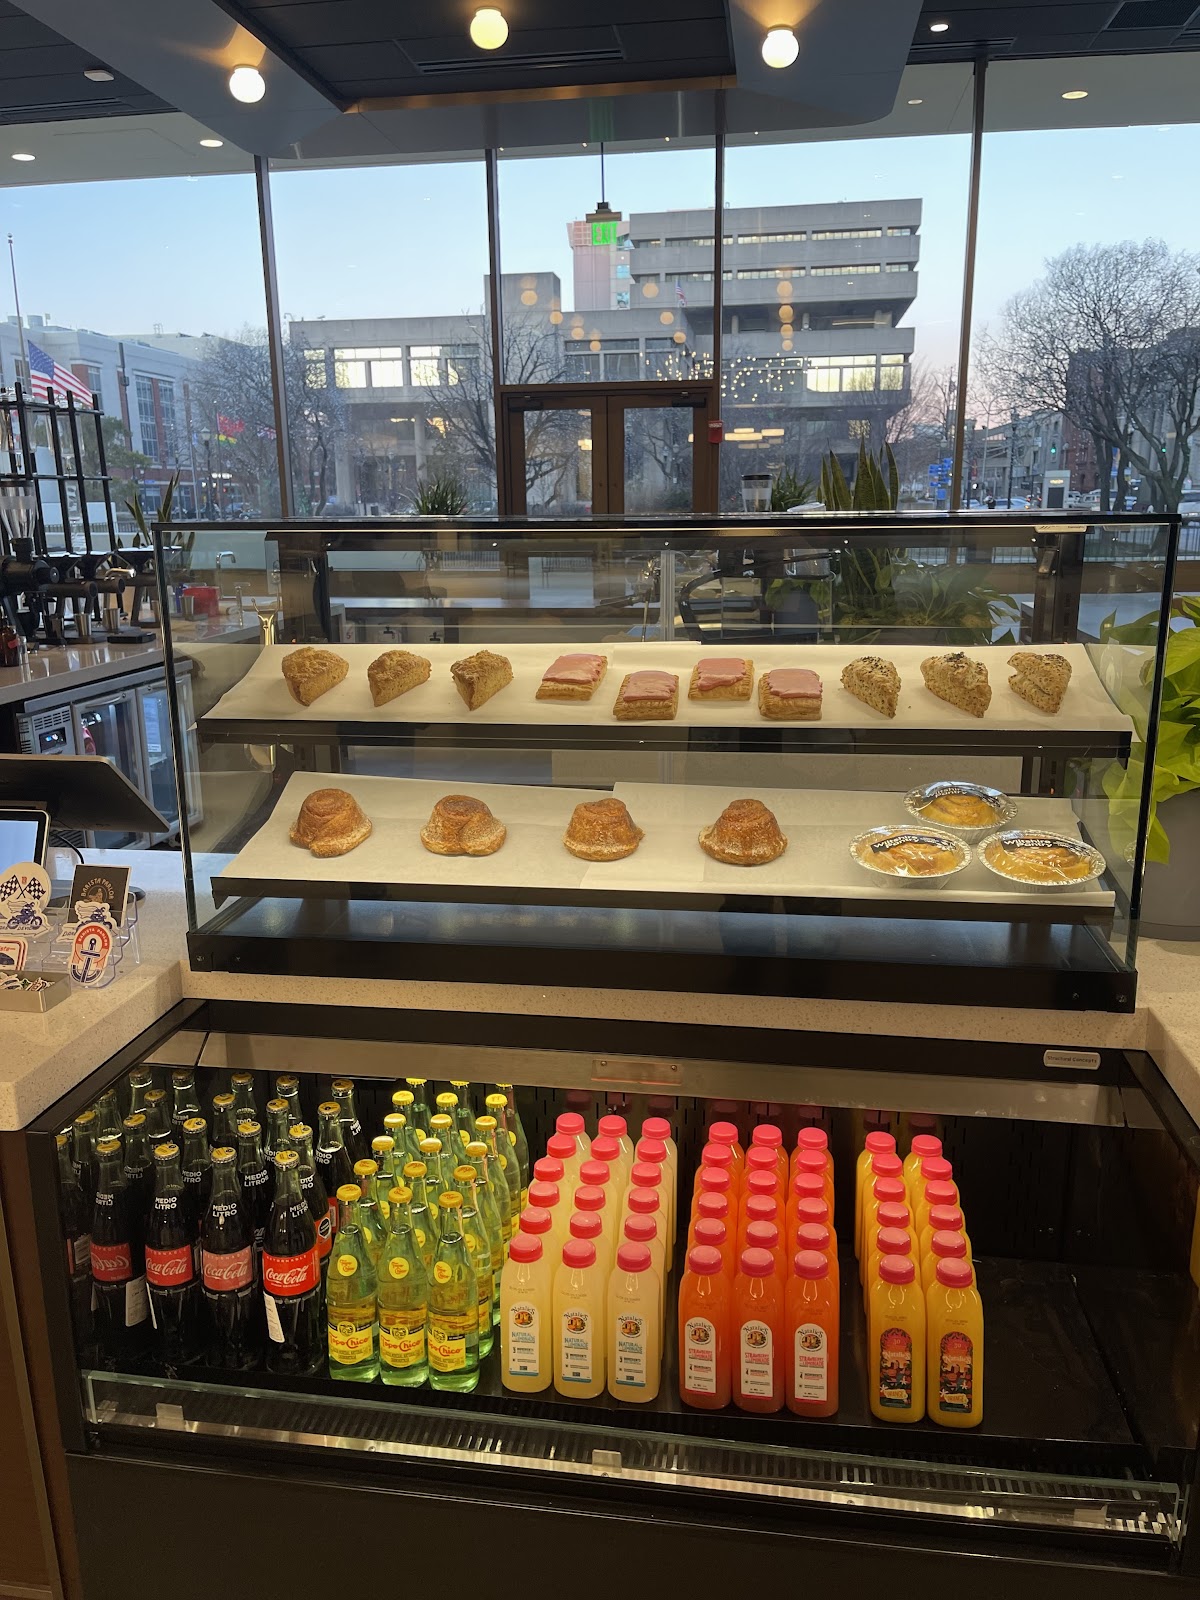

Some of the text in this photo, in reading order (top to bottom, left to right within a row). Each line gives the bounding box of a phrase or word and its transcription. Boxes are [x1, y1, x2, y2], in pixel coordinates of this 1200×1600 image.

[592, 221, 617, 245] EXIT
[244, 1170, 267, 1181] MEDIO
[154, 1202, 178, 1210] LITRO
[212, 1203, 237, 1211] MEDIO
[212, 1209, 238, 1217] LITRO
[329, 1331, 370, 1349] Topo Chico
[381, 1335, 422, 1352] Topo Chico
[439, 1345, 463, 1357] Chico
